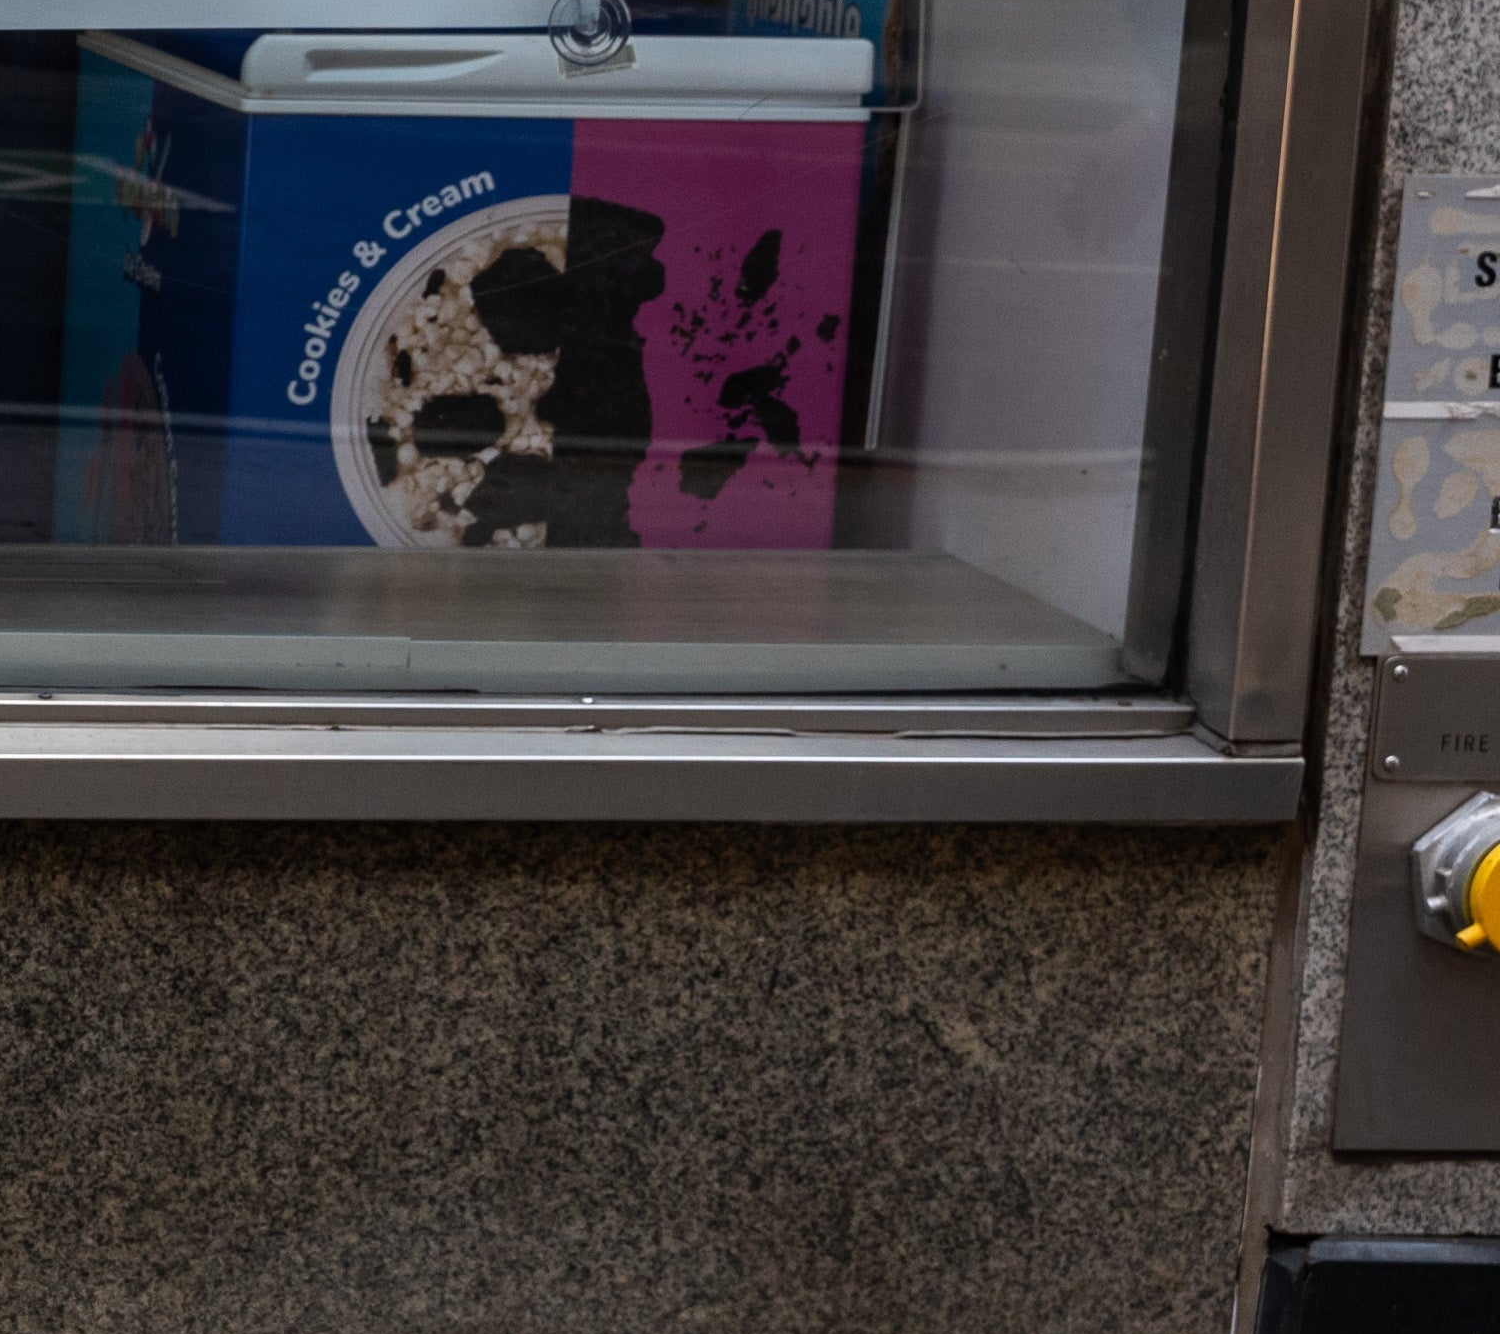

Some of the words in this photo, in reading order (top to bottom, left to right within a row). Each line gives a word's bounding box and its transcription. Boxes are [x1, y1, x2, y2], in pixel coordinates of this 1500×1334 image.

[287, 273, 358, 409] Cookies
[354, 230, 390, 272] &
[382, 167, 498, 243] Cream
[1440, 733, 1488, 753] FIRE
